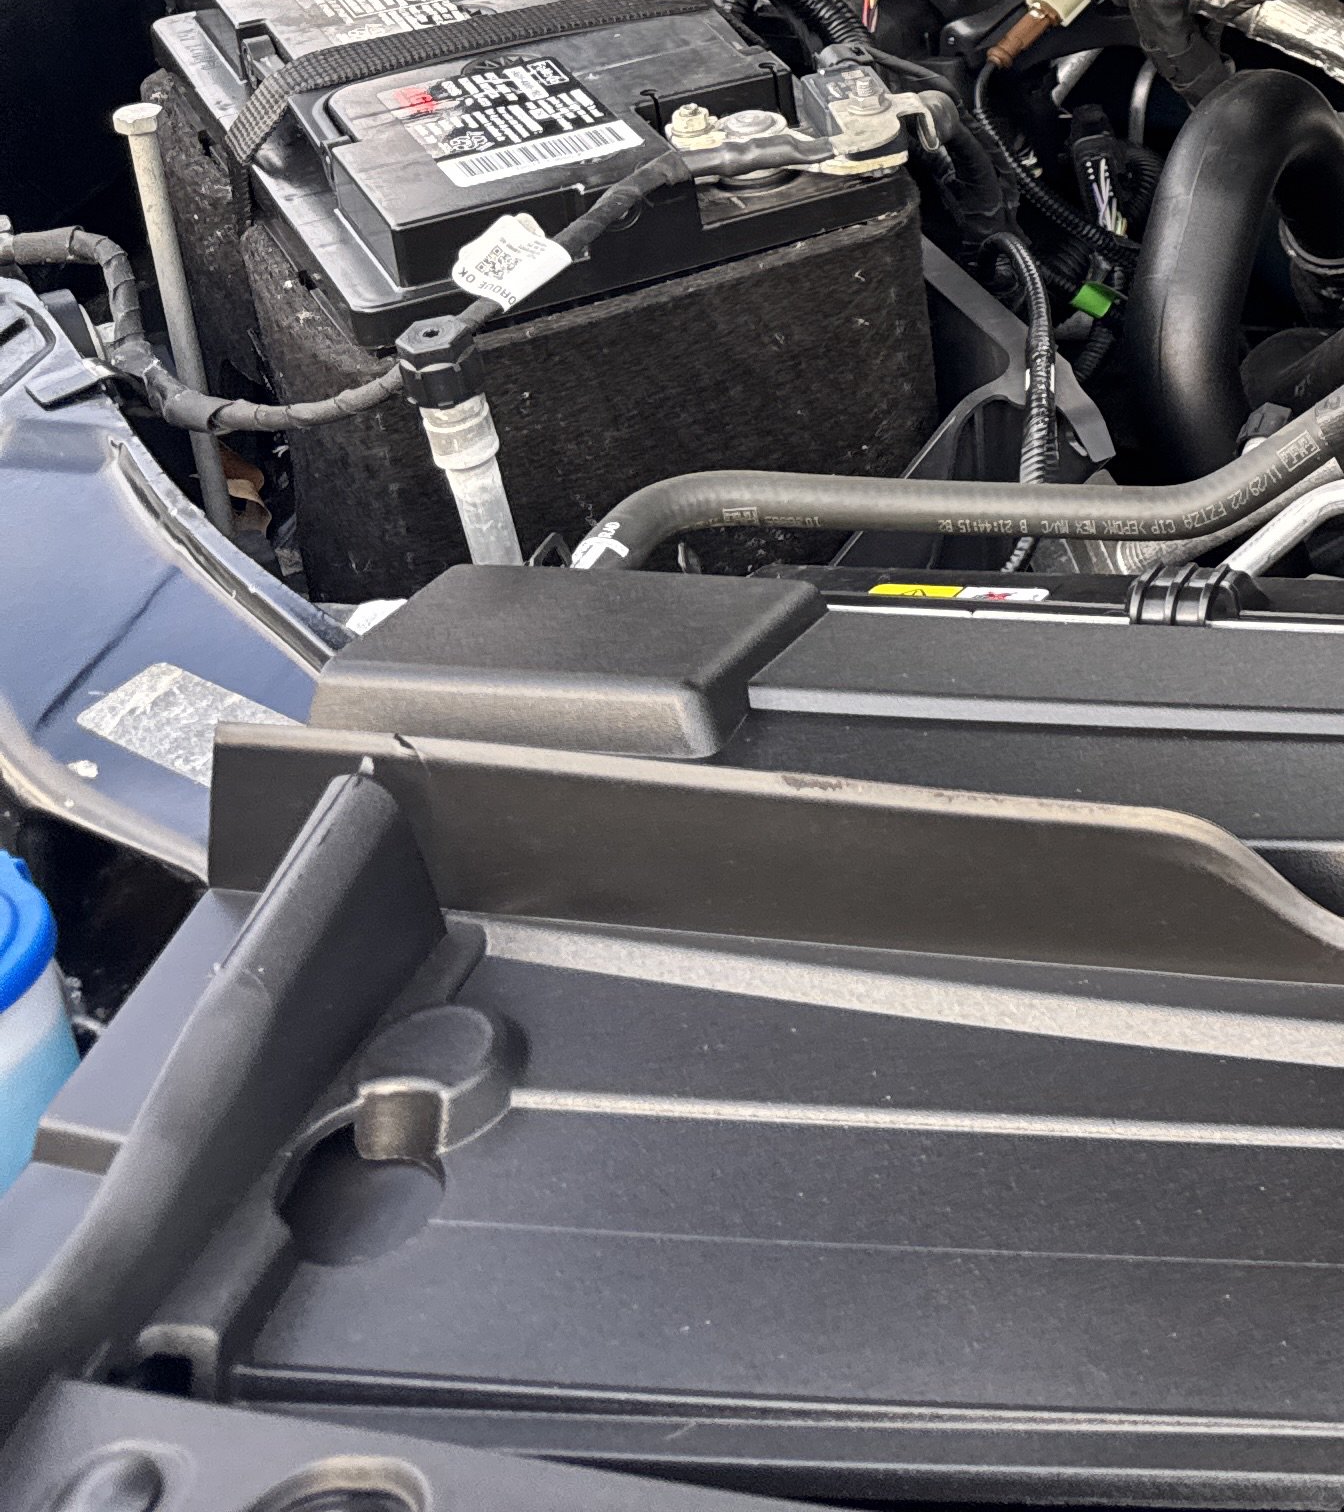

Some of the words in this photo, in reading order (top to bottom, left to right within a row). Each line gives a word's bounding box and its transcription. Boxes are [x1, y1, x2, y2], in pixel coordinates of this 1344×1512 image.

[457, 266, 476, 284] OK
[1226, 464, 1283, 509] 11/29/22
[958, 518, 1013, 533] 21:44:15
[1019, 518, 1028, 533] B
